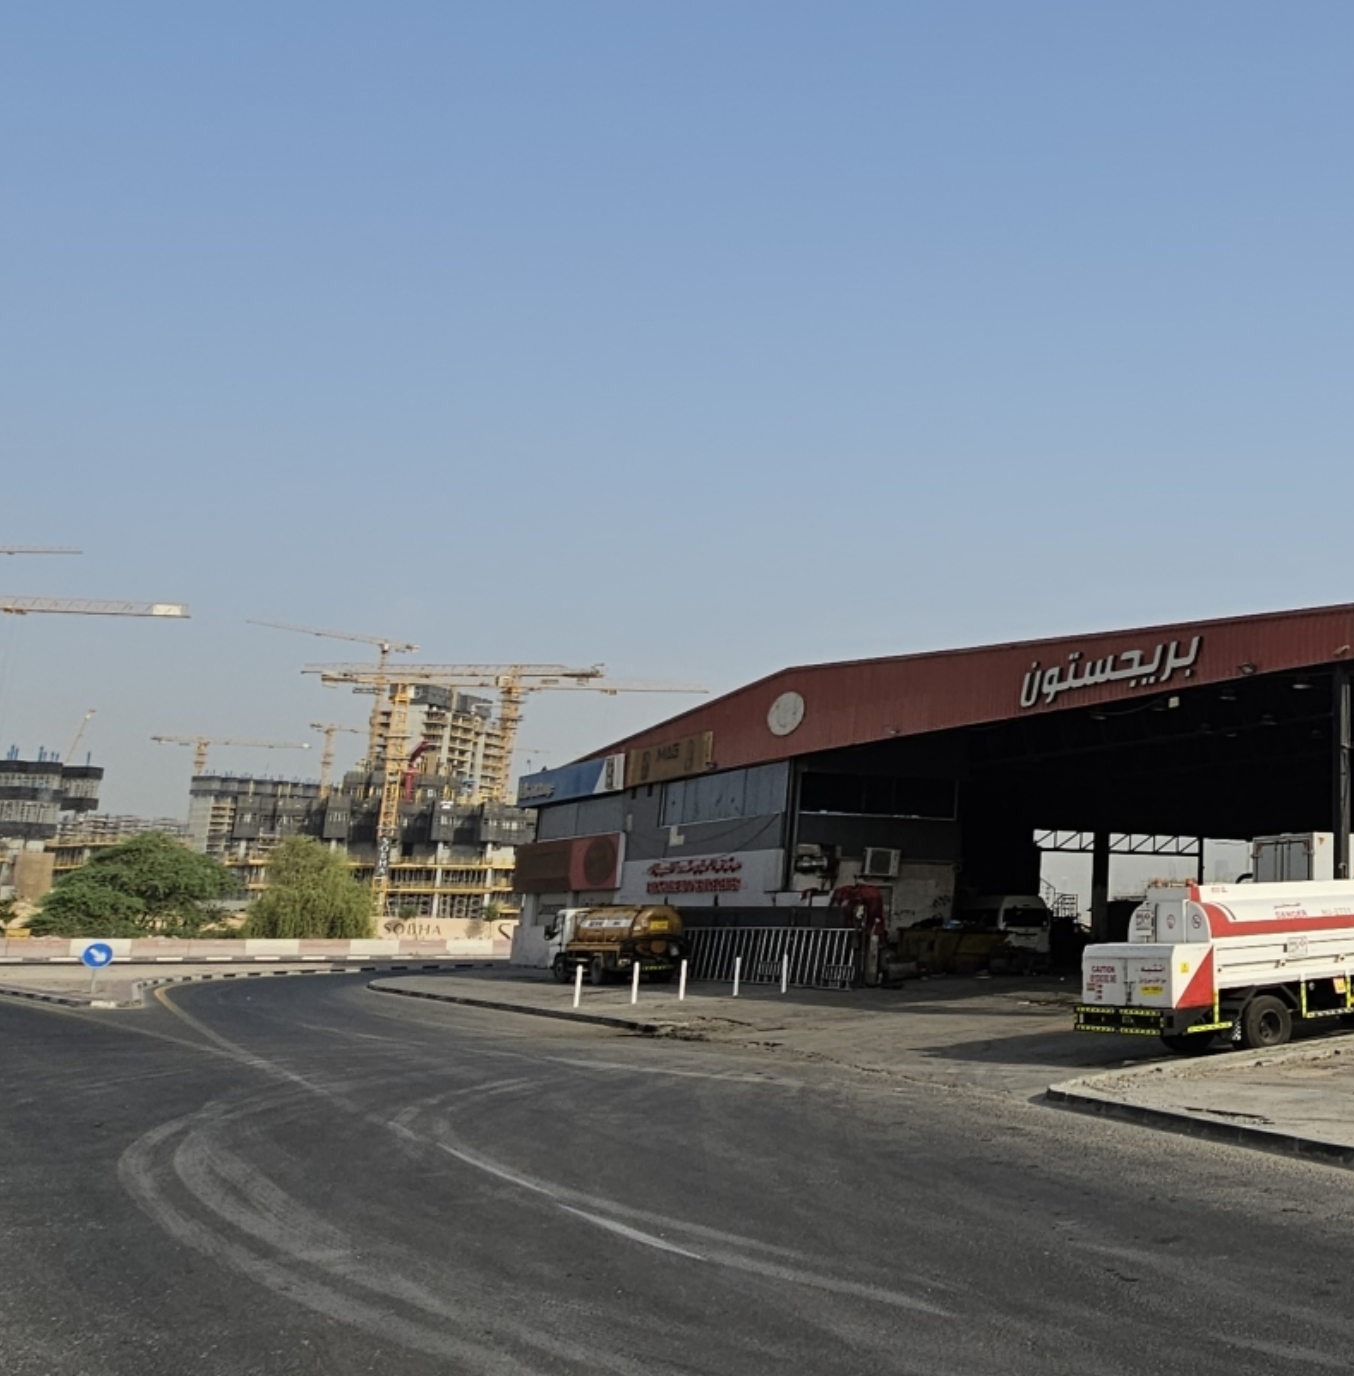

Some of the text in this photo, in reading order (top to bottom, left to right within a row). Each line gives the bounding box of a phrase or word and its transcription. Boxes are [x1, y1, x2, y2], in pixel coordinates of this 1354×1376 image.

[1020, 636, 1200, 707] بريجستون
[383, 922, 442, 936] SOBHA
[1091, 965, 1115, 974] CAUTION
